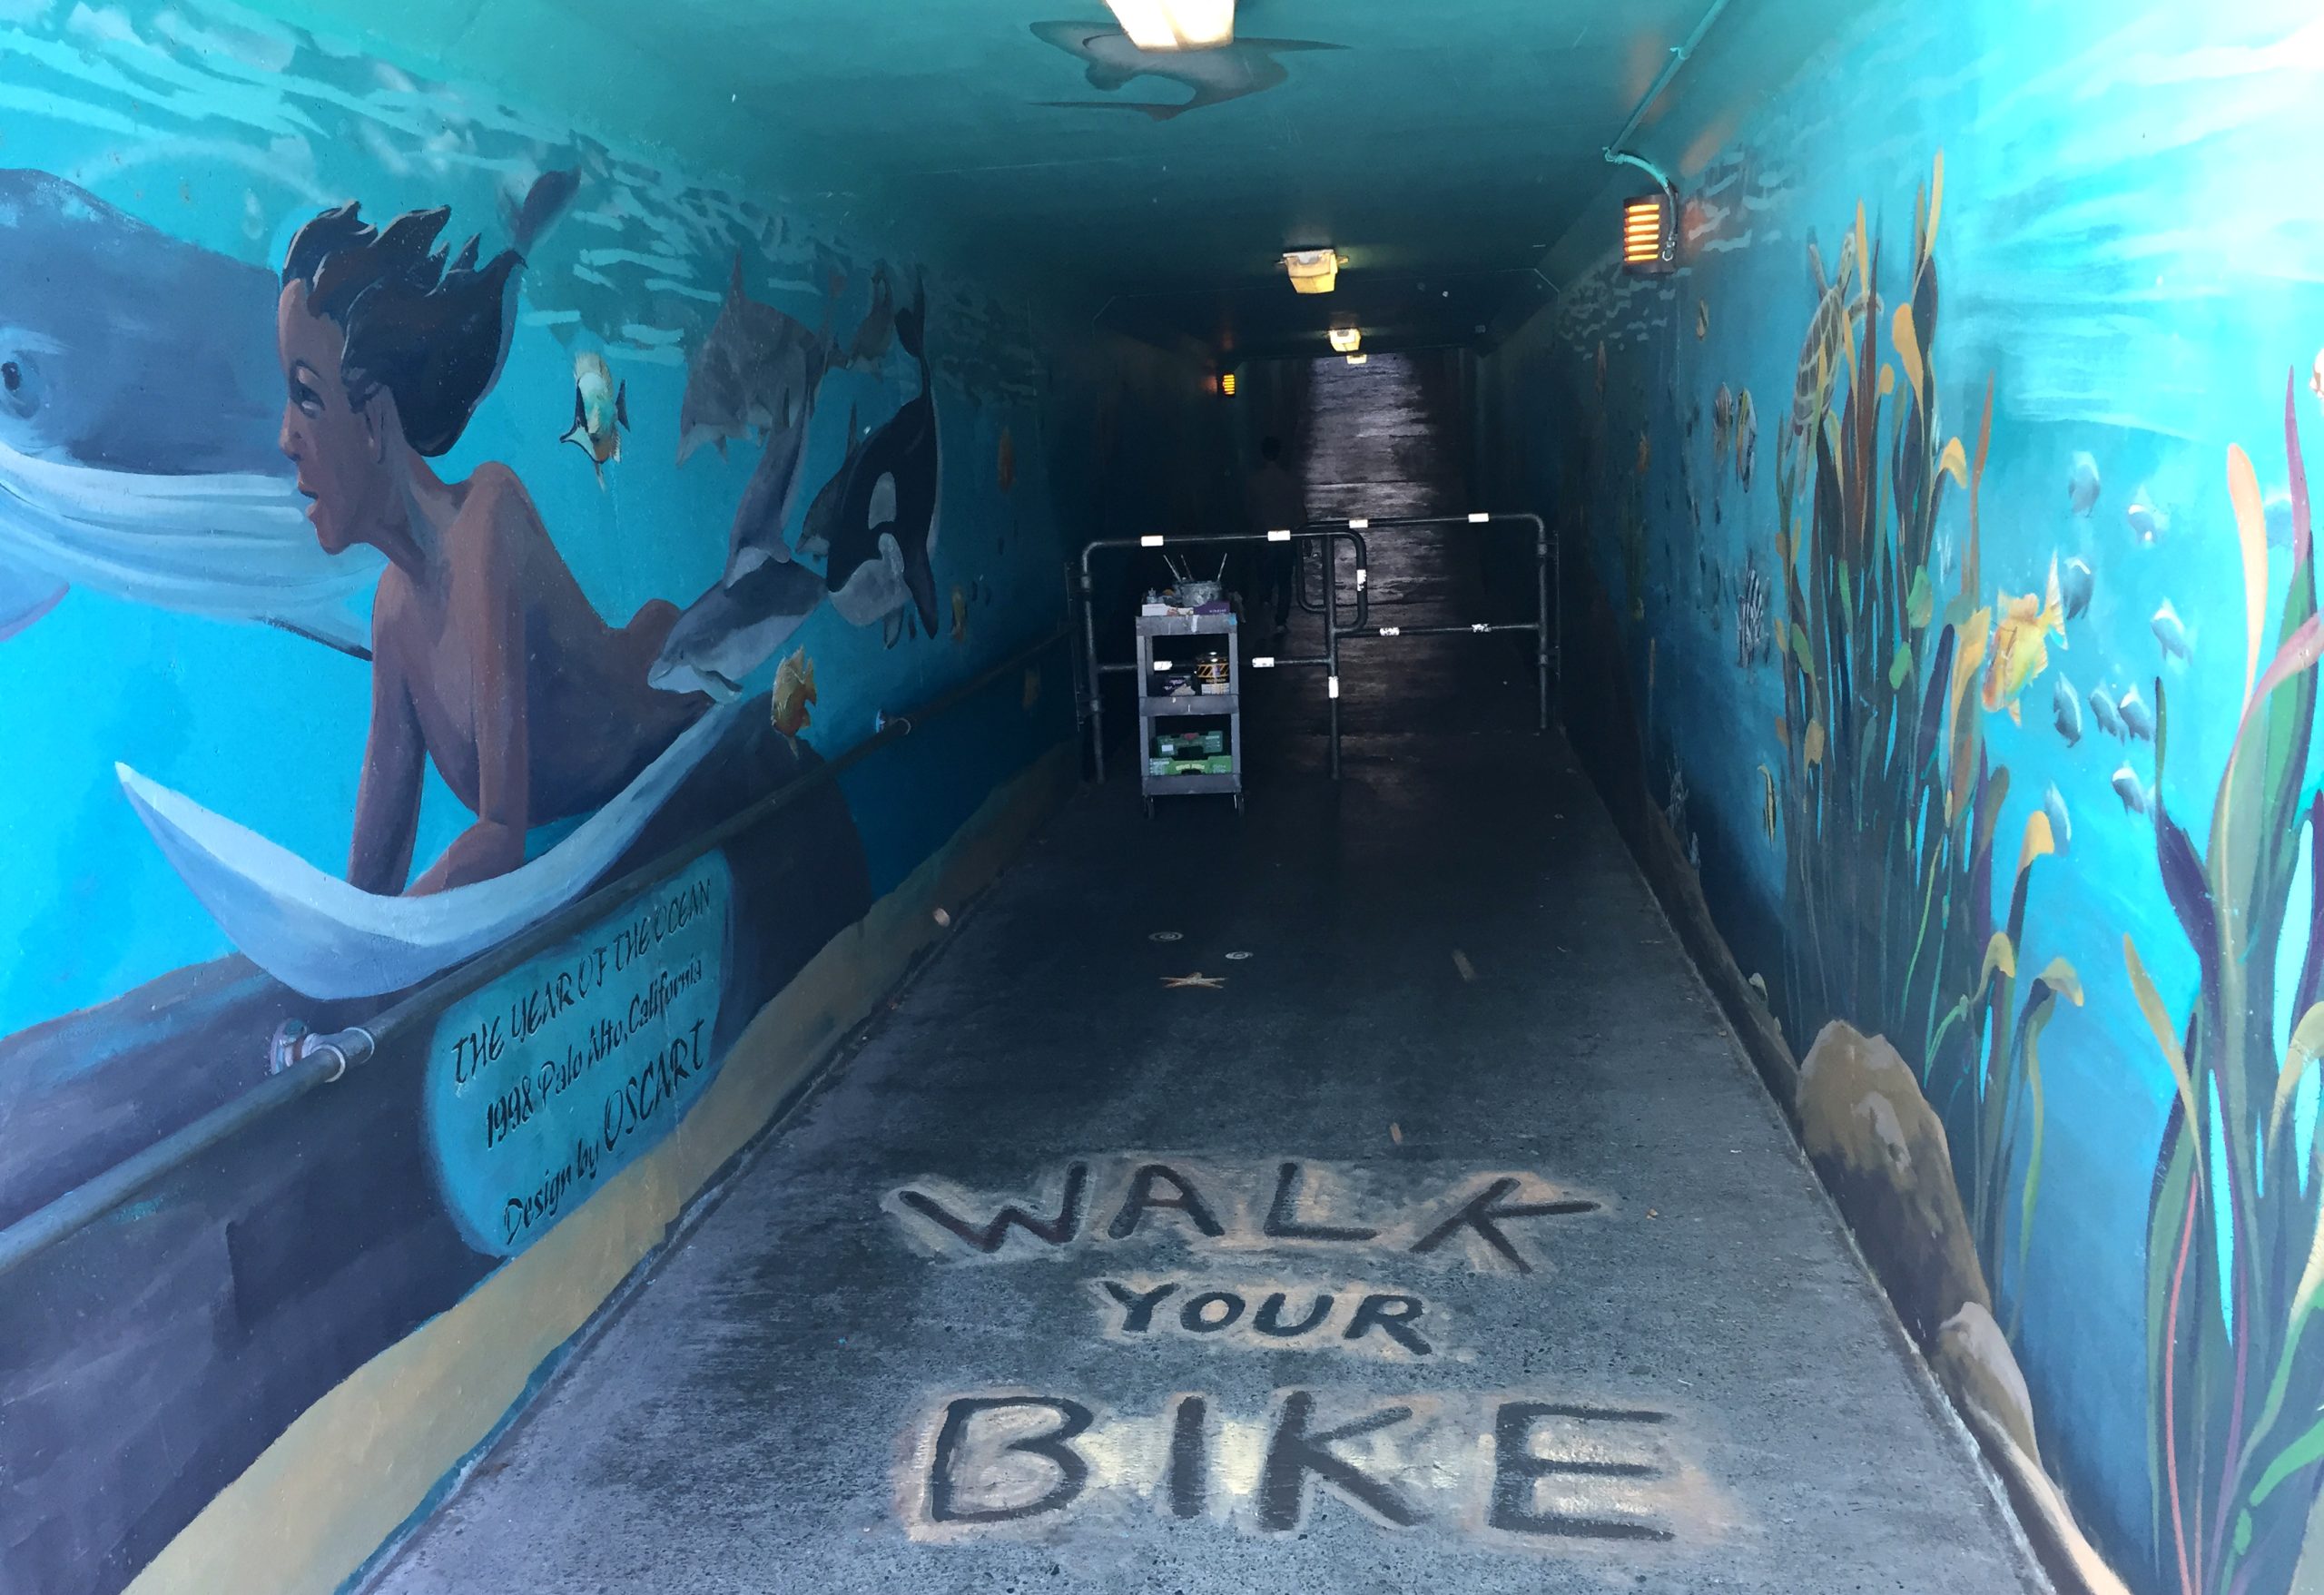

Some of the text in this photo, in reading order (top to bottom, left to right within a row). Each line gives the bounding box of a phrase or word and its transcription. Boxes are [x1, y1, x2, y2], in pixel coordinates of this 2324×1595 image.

[452, 878, 711, 1084] THE YEAR OF THE OCEAN
[487, 1076, 535, 1147] 1998
[537, 1044, 583, 1102] Palo
[628, 953, 703, 1034] California
[503, 1018, 705, 1245] Design by OSCART
[900, 1161, 1602, 1274] WALK
[1102, 1281, 1433, 1356] YOUR
[929, 1391, 1676, 1542] BIKE
